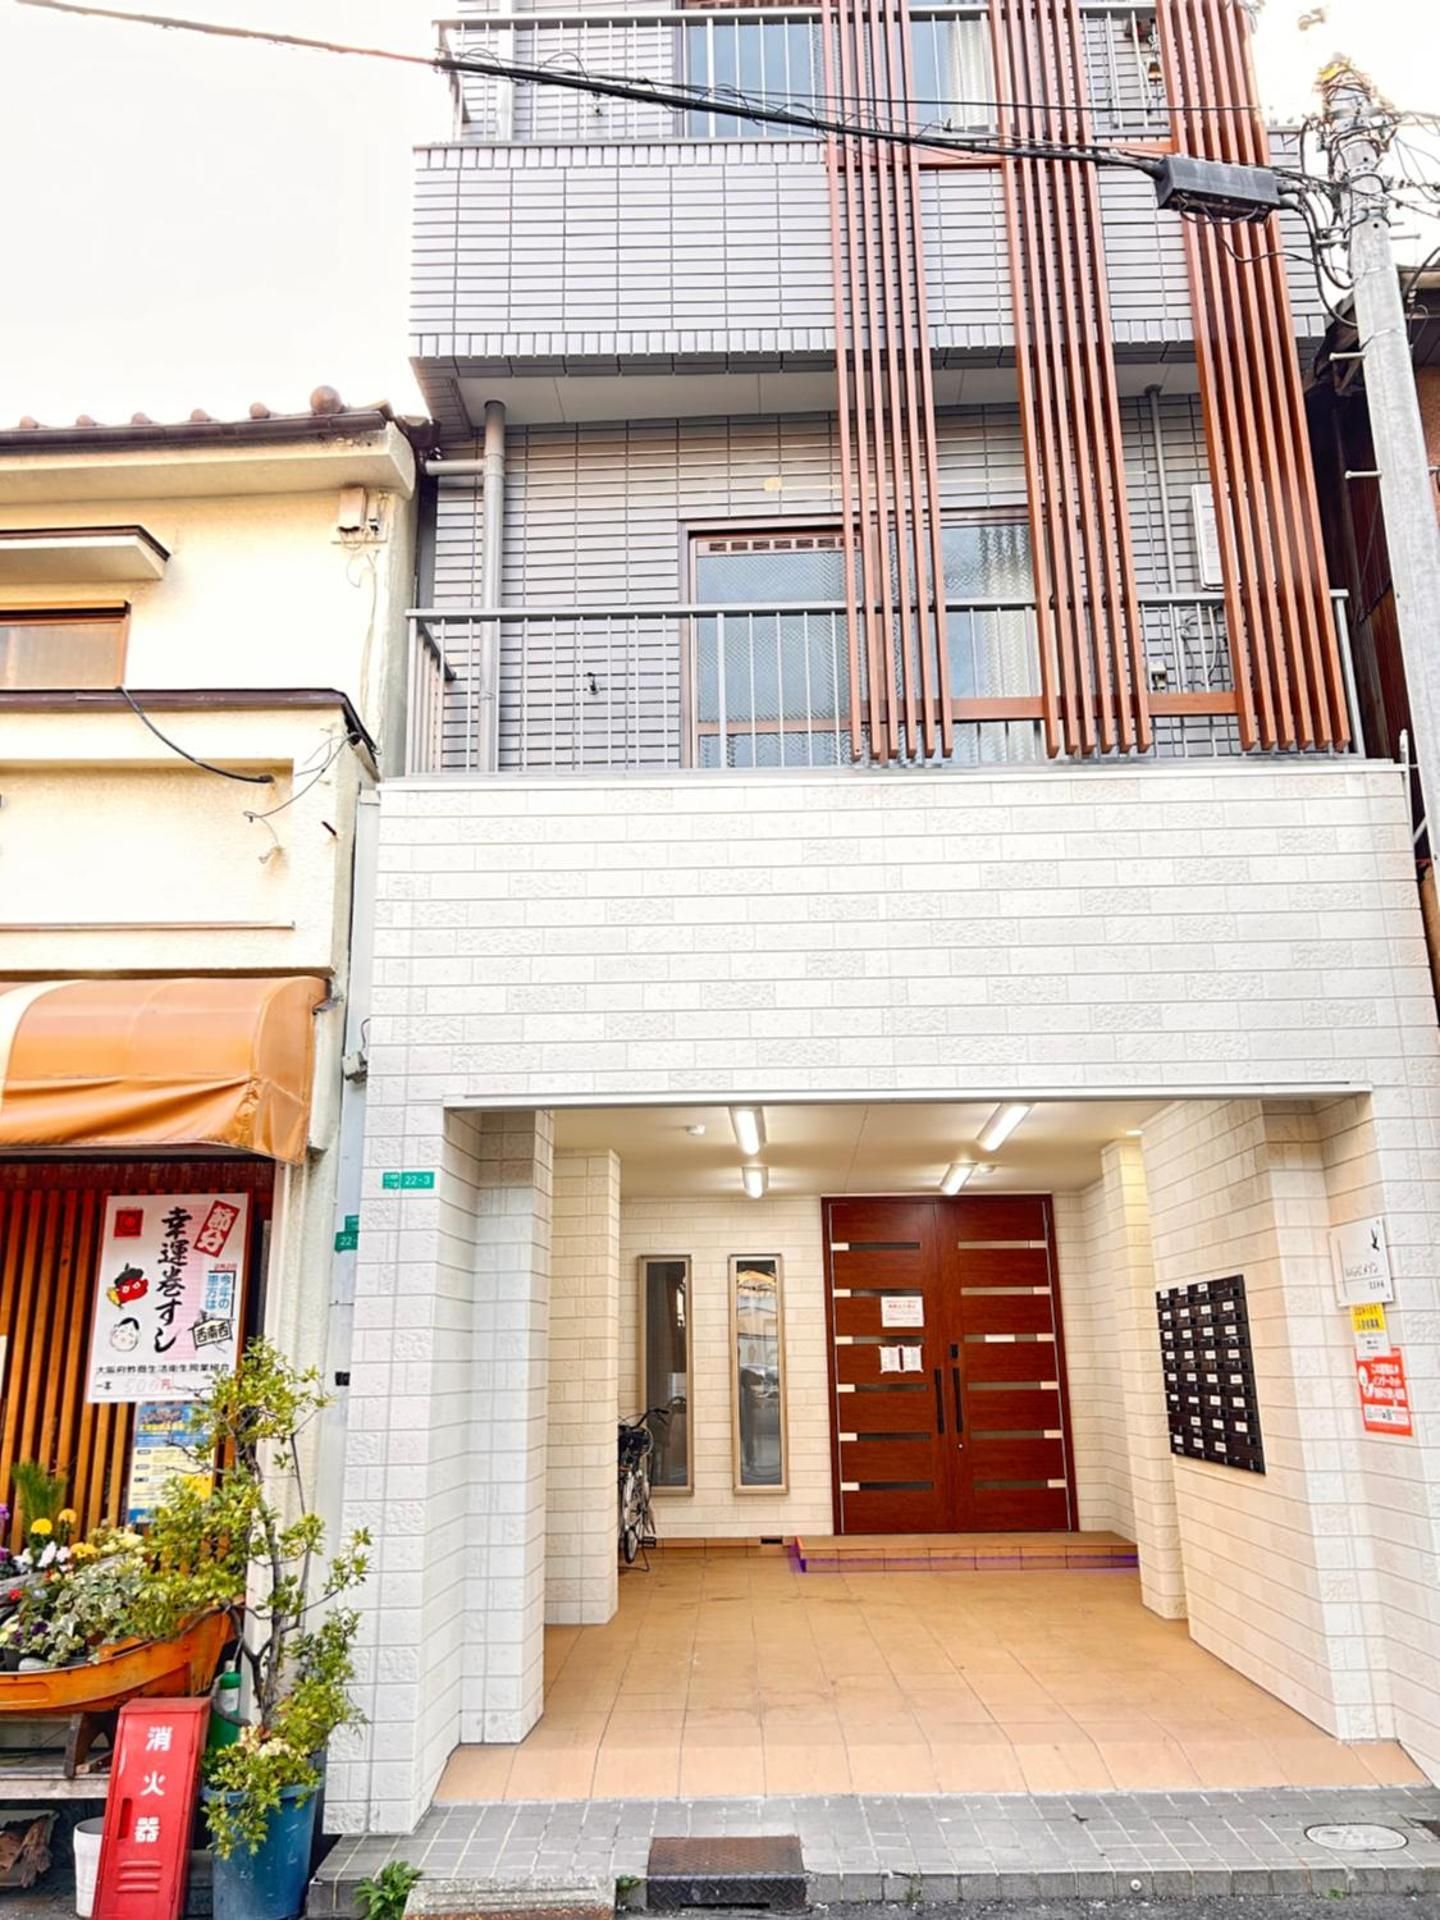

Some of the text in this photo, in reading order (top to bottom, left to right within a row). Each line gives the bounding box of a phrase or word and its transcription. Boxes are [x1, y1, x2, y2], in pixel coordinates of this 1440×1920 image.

[404, 1175, 431, 1185] 22-3
[197, 1205, 235, 1253] 節分
[154, 1207, 193, 1353] 幸運巻すし
[134, 1726, 173, 1843] 消火器
